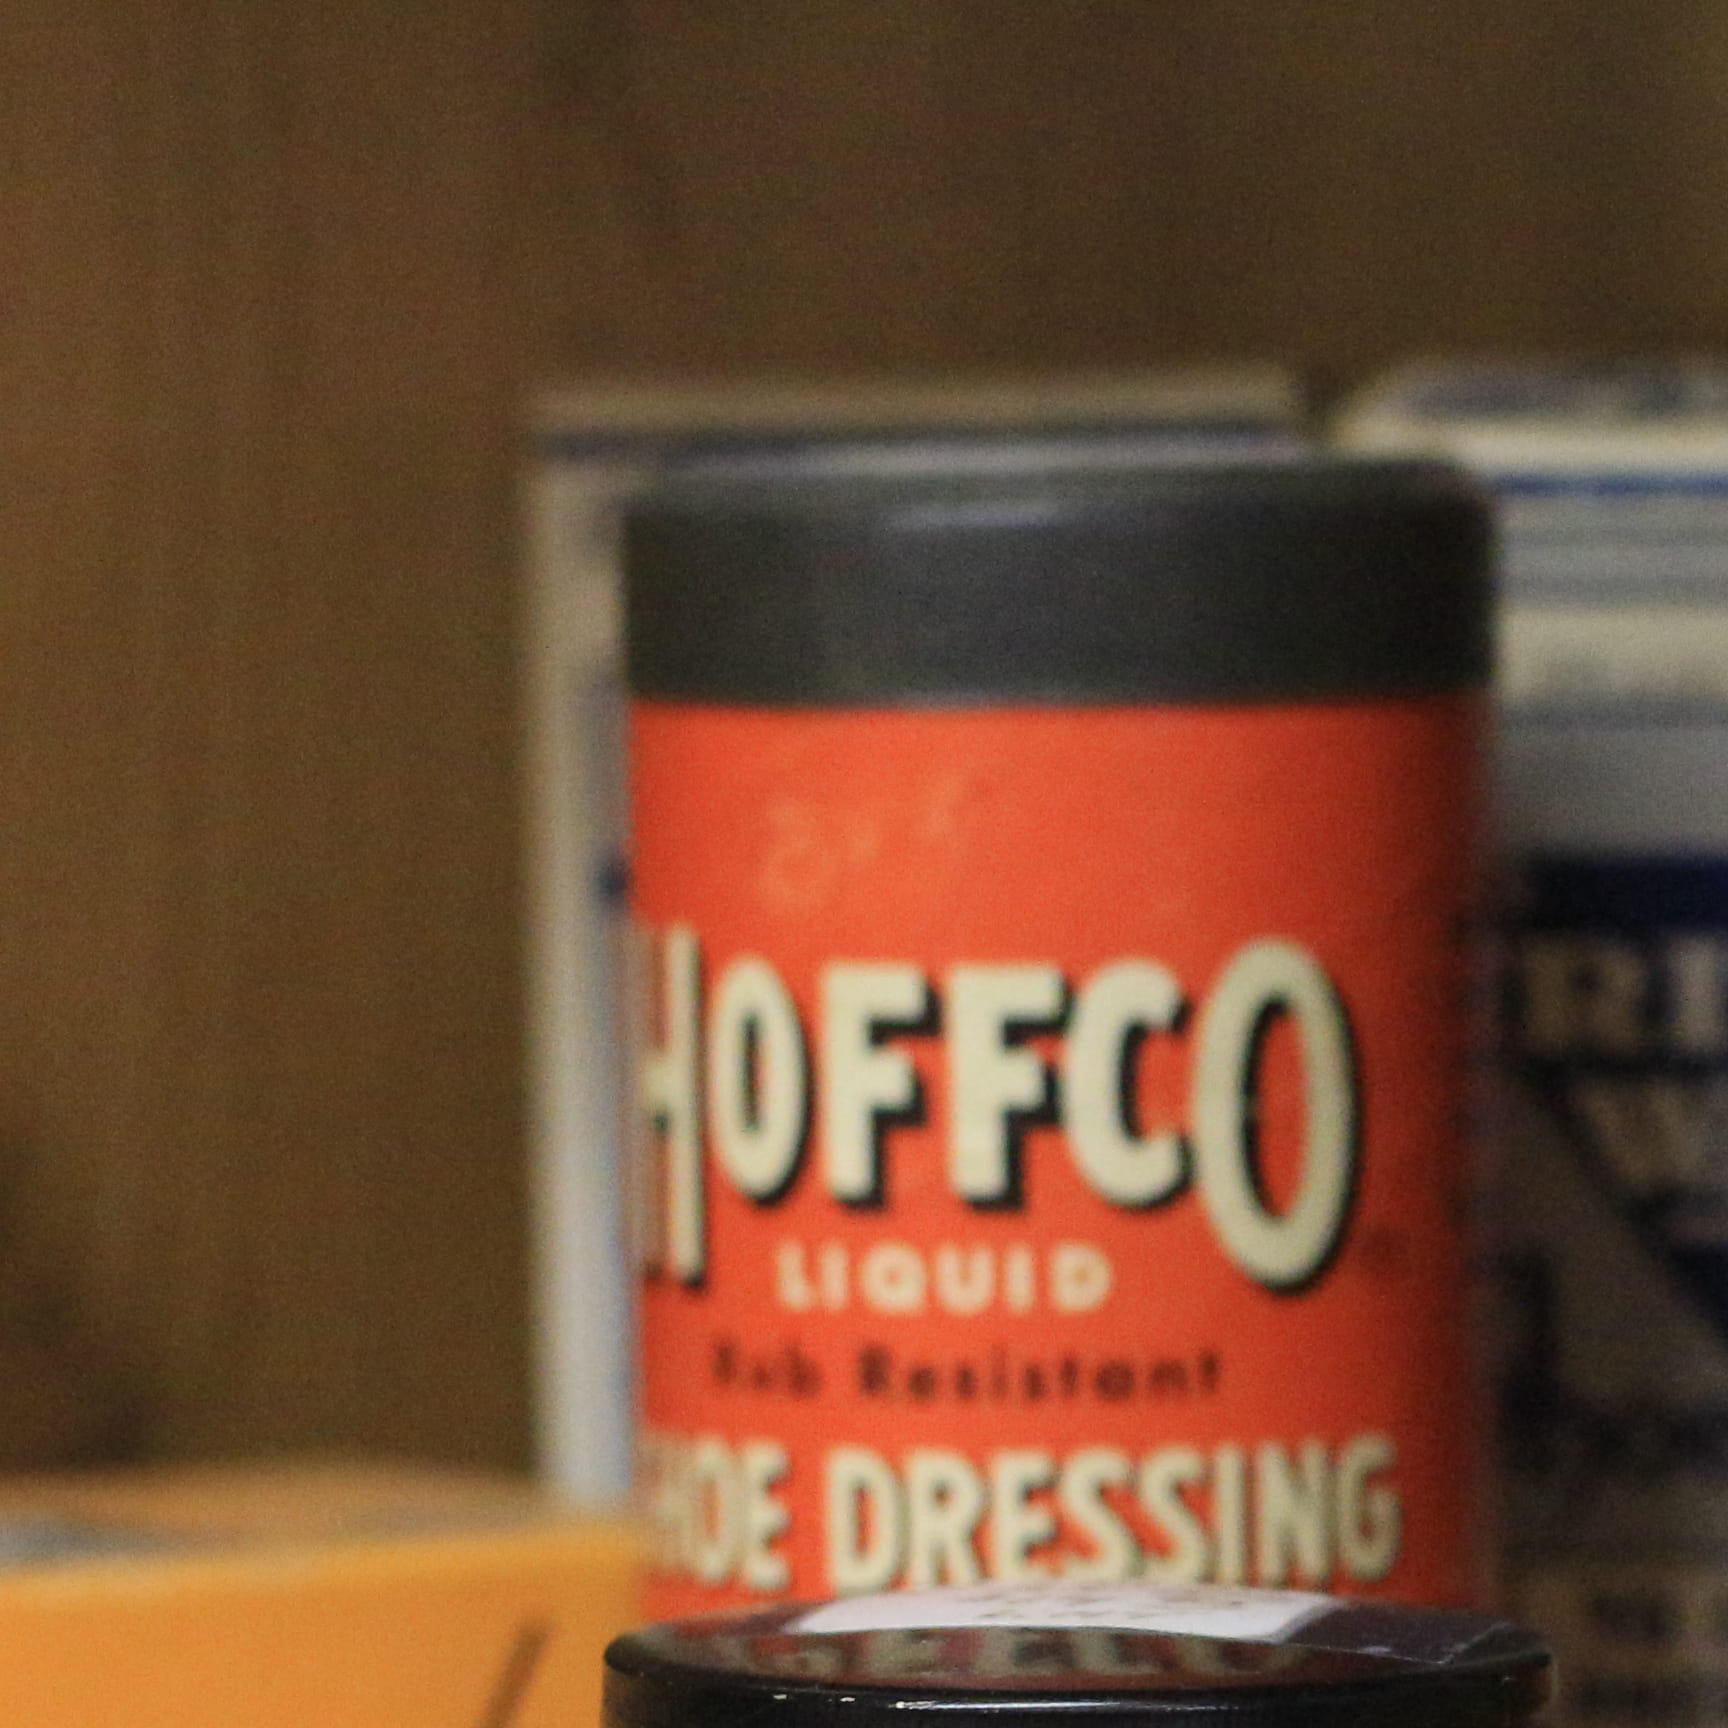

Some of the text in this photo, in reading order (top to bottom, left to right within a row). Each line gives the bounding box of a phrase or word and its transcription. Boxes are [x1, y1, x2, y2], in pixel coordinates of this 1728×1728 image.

[776, 1242, 1114, 1315] LIQUID
[857, 1340, 1222, 1402] Resistant
[825, 1438, 1402, 1592] DRESSING
